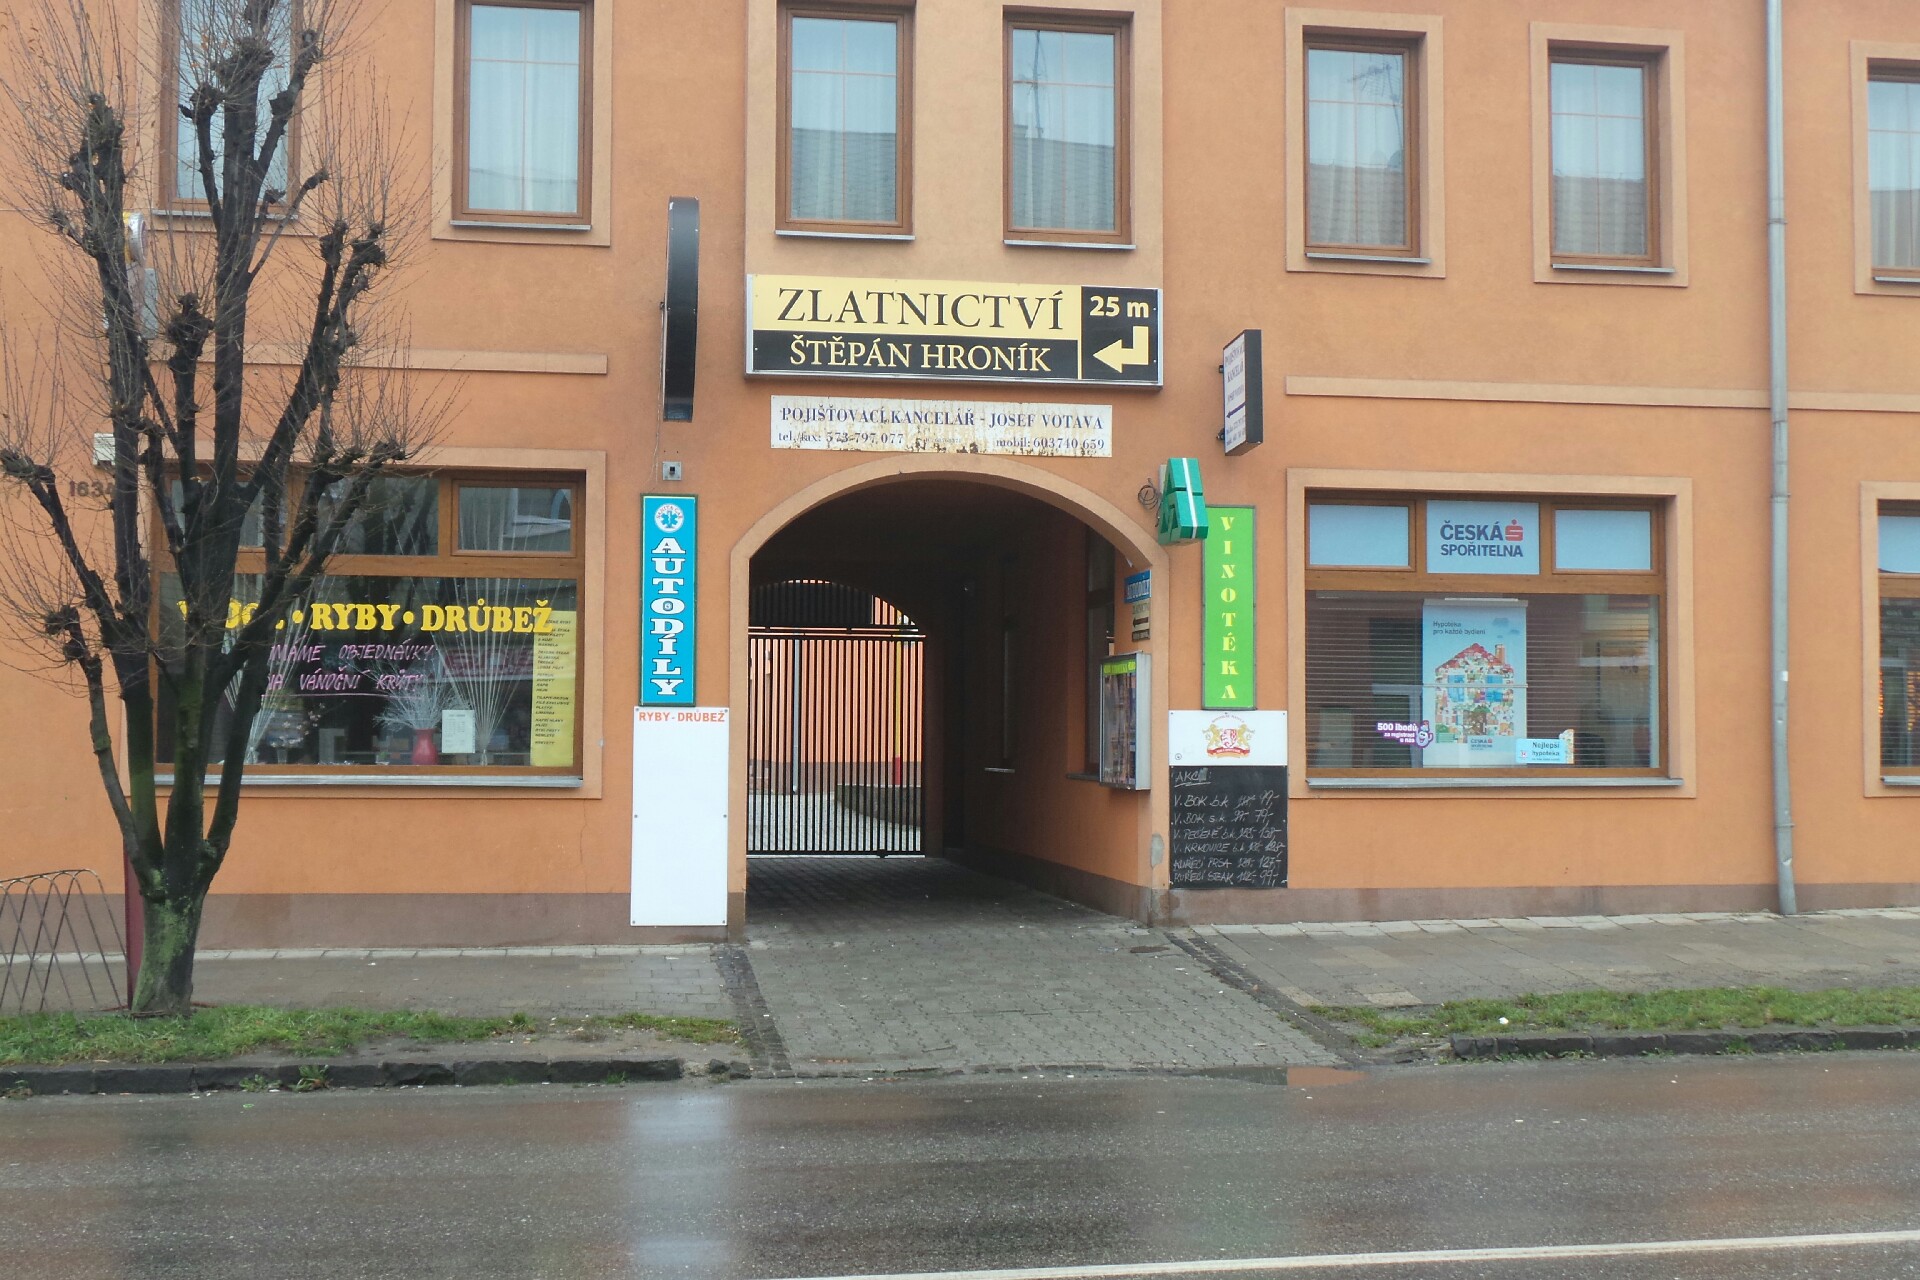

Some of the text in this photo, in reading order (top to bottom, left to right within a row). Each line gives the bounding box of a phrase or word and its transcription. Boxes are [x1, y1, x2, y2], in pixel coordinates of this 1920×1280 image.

[777, 287, 1064, 330] ZLATNICTVÍ
[1089, 296, 1150, 318] 25 m
[789, 333, 1052, 372] ŠTĚPÁN HRONÍK
[781, 403, 887, 424] POJIŠŤOVACÍ
[890, 408, 976, 426] KANCELÁŘ
[989, 412, 1036, 428] JOSEF
[1041, 414, 1104, 430] VOTAVA
[996, 437, 1031, 448] mobil:
[1440, 520, 1504, 541] ČESKÁ
[1440, 542, 1524, 557] SPOŘITELNA
[311, 603, 401, 631] RYBY
[420, 598, 554, 633] DRŮBEŽ
[650, 537, 687, 696] AUTODÍLY
[1220, 516, 1239, 699] VINOTÉKA
[338, 638, 435, 661] OBJEDNÁVKY
[638, 711, 669, 722] RYBY
[677, 709, 726, 723] DRŮBEŽ
[1377, 722, 1394, 731] 500
[1184, 794, 1208, 808] BOK
[1183, 812, 1205, 825] BOK
